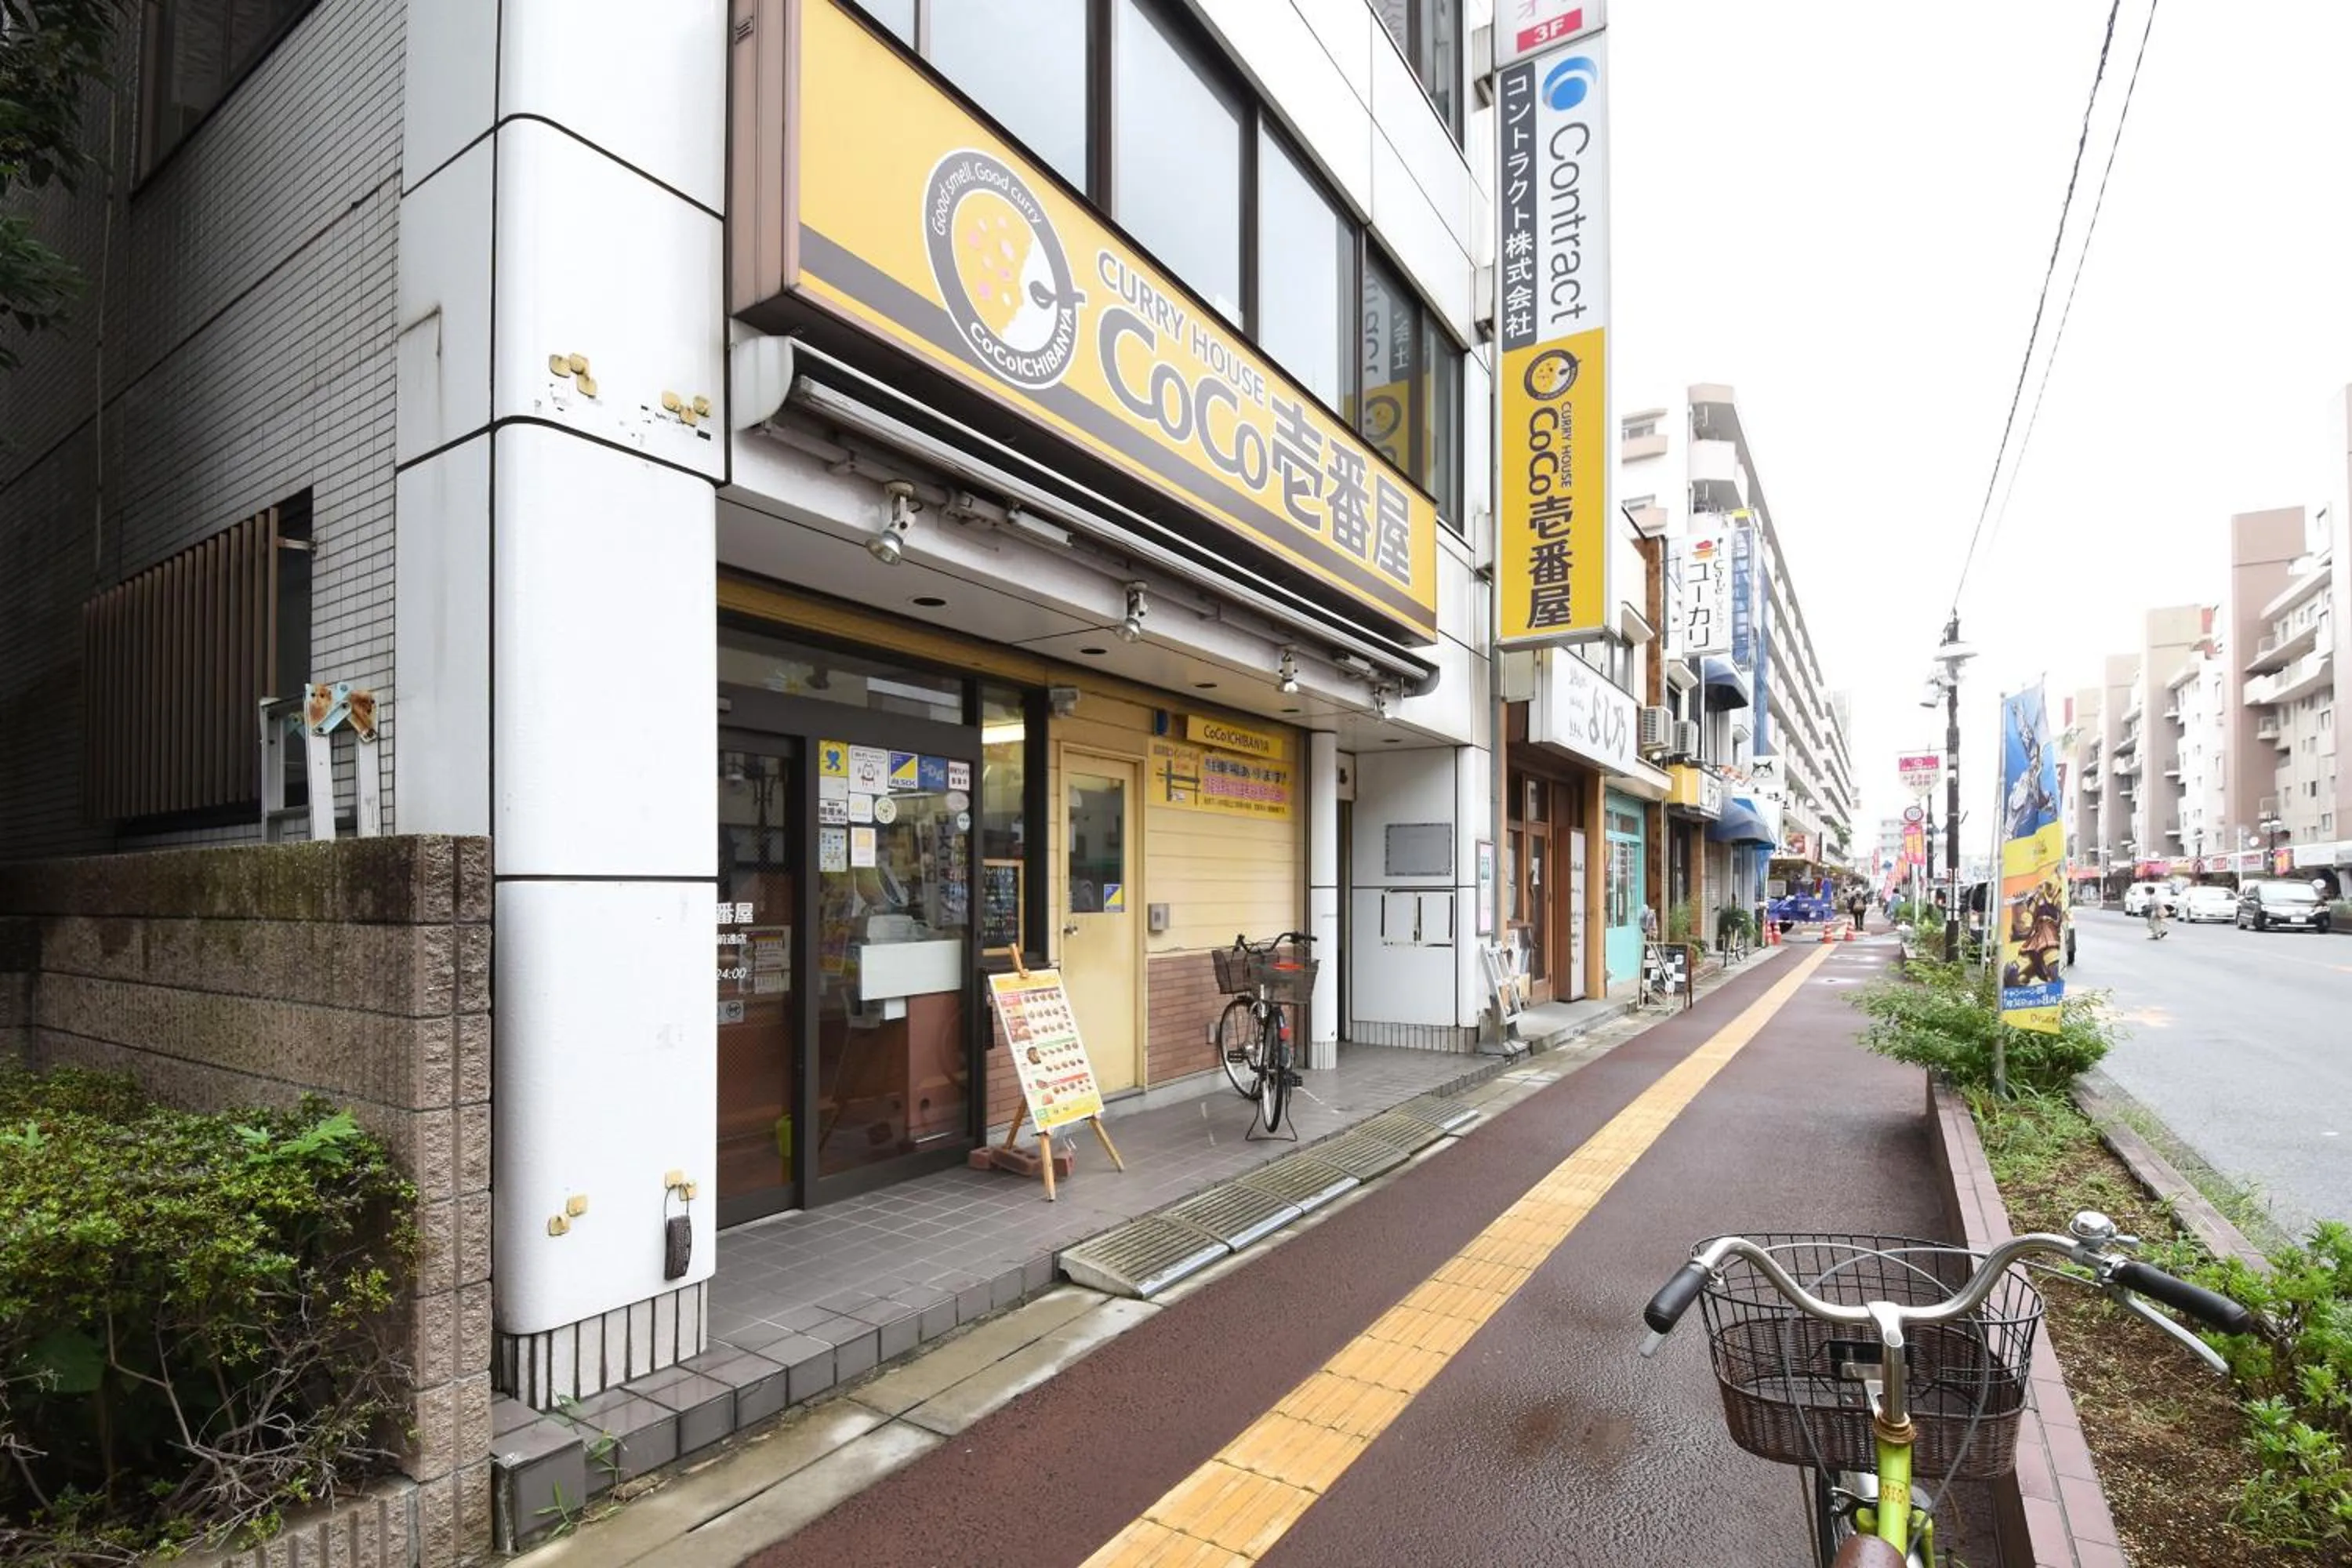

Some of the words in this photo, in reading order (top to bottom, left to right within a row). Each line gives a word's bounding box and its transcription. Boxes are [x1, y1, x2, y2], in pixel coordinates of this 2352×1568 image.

[1533, 17, 1565, 43] 3F
[932, 182, 951, 236] Good
[975, 162, 1009, 191] Good
[1011, 187, 1042, 224] curry
[1505, 74, 1534, 339] コントラクト株式会社
[1549, 122, 1590, 325] Contract
[970, 308, 1073, 377] CoCoICHIBANYA
[1098, 250, 1185, 340] CURRY
[1191, 322, 1265, 407] HOUSE
[1098, 307, 1411, 588] CoCo壱番屋
[1561, 401, 1572, 440] CURRY
[1561, 444, 1572, 488] HOUSE
[1527, 407, 1573, 630] CoCo壱番屋
[1688, 562, 1711, 648] ユーカリ
